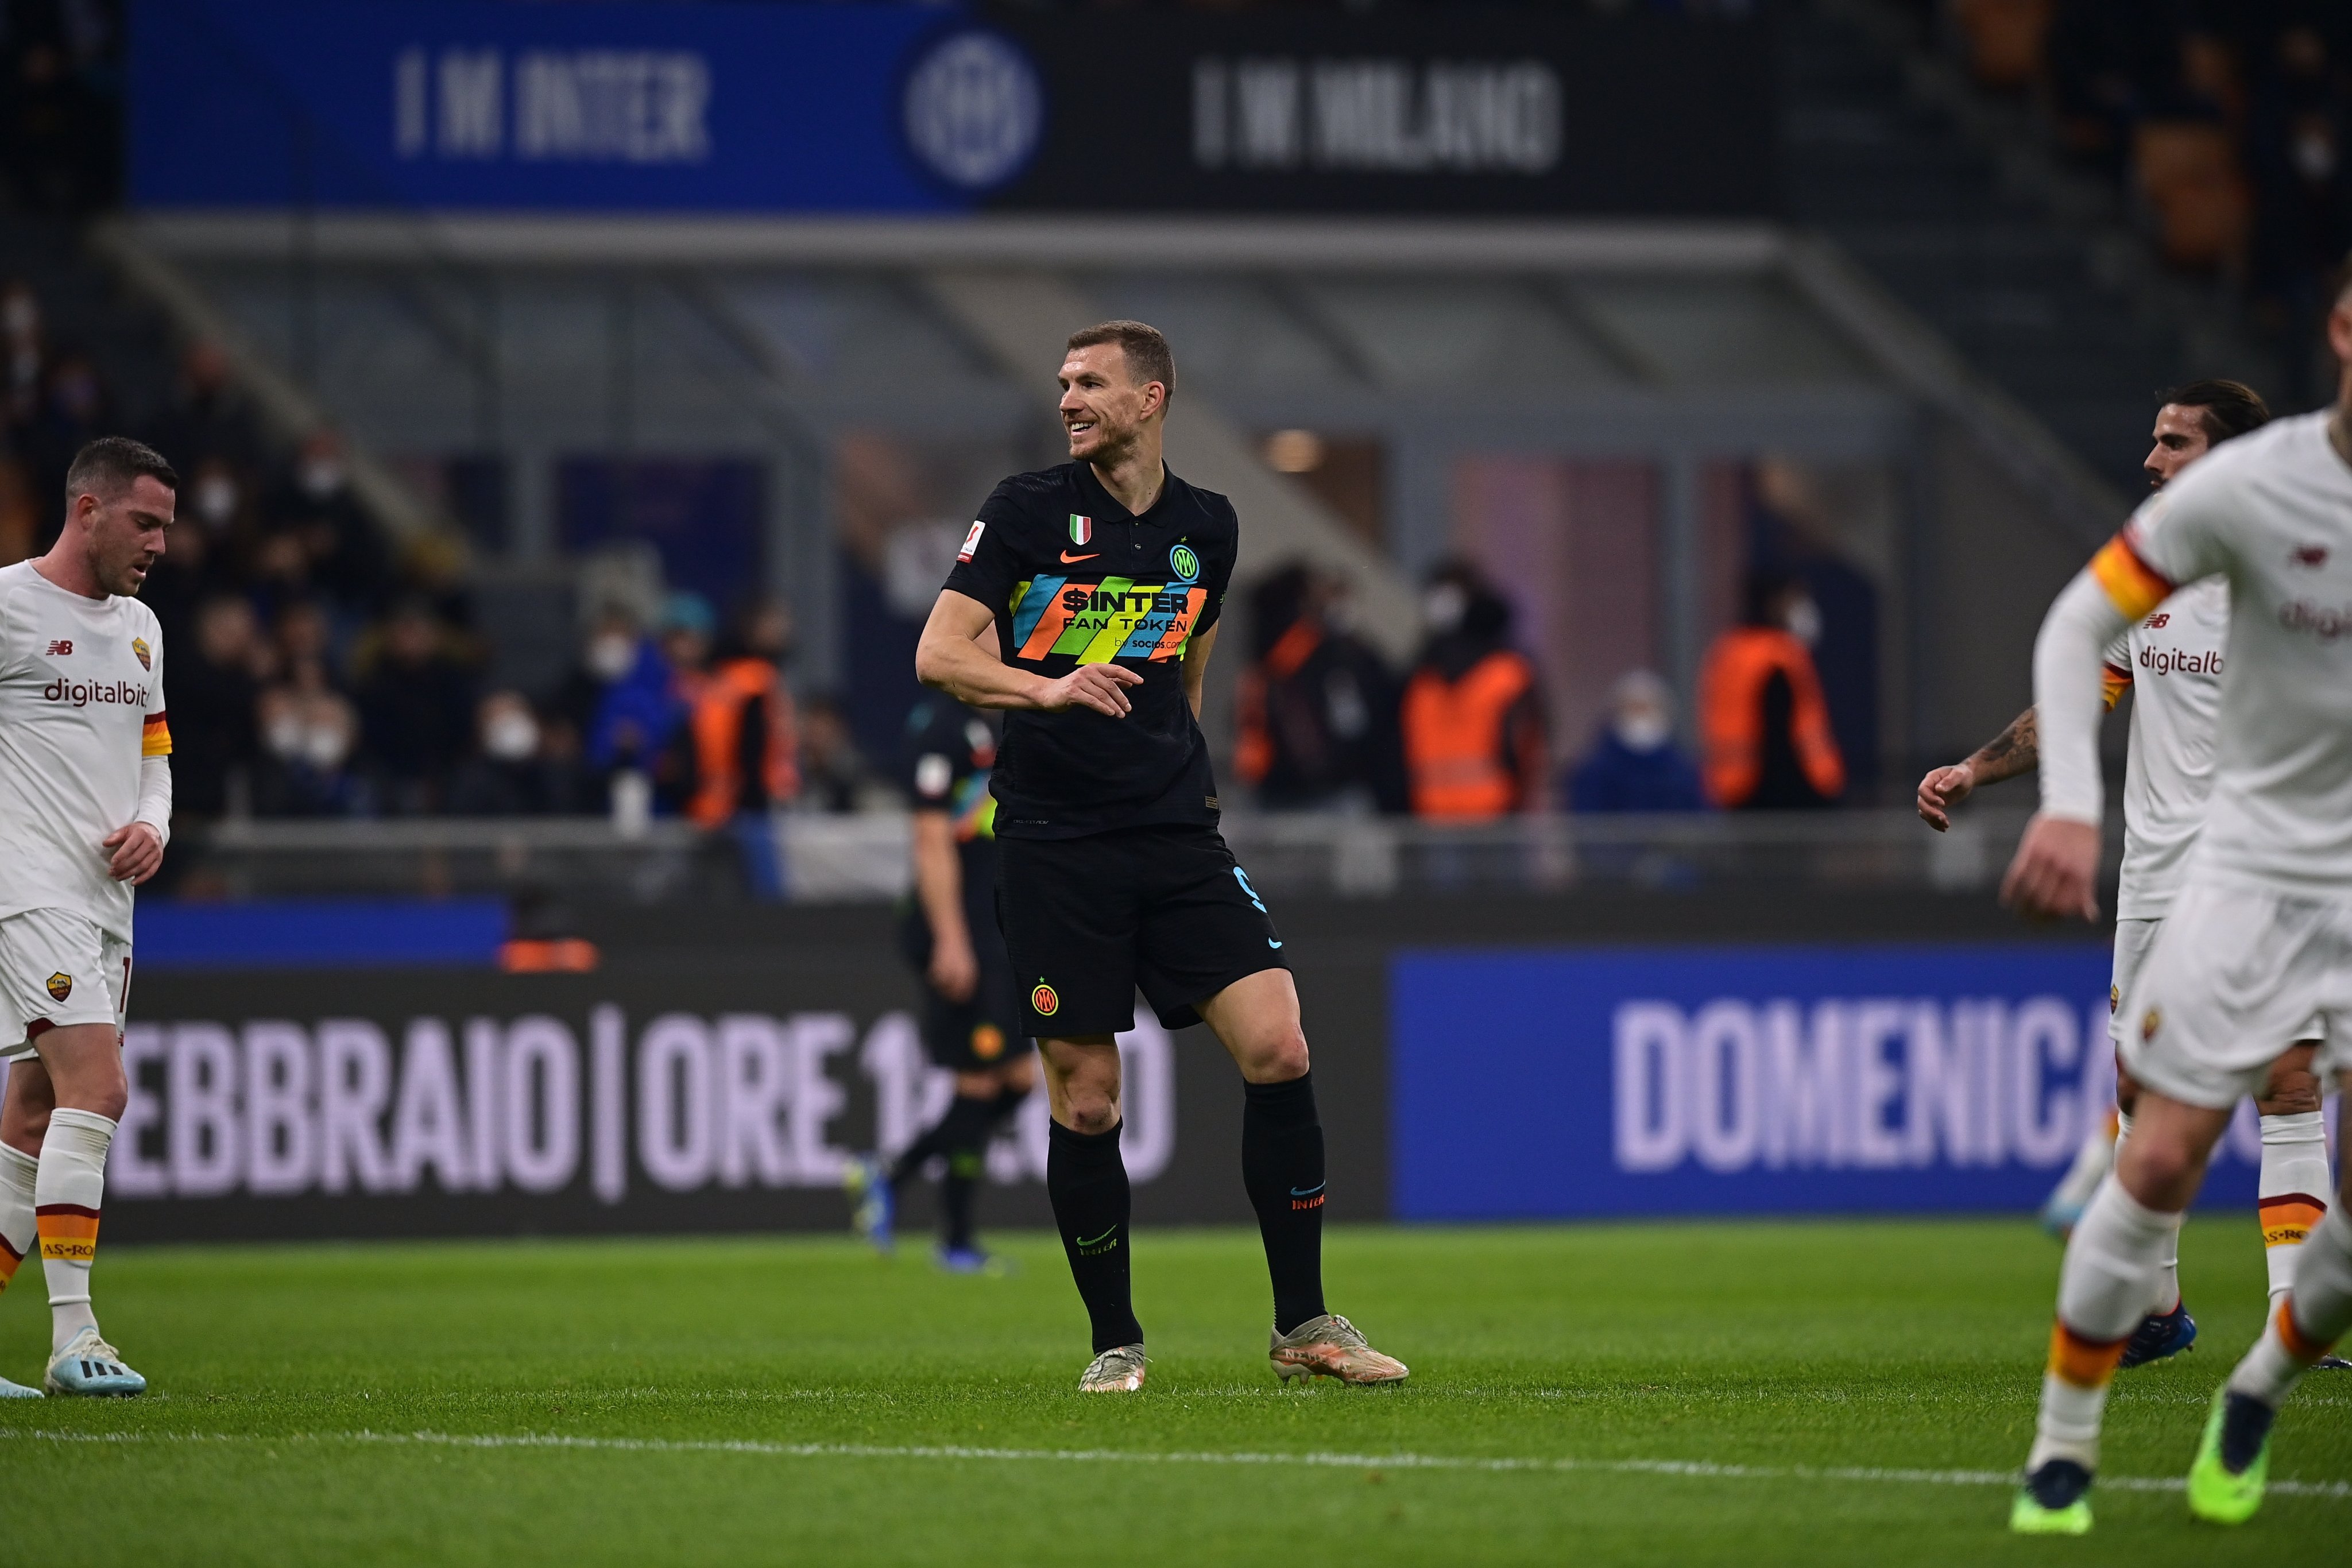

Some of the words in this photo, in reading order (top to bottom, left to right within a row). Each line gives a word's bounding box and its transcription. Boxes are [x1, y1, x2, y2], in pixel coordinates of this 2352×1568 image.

[1062, 588, 1188, 614] $INTER
[1063, 618, 1108, 630] FAN
[1120, 618, 1187, 632] TOKEN
[1115, 637, 1128, 649] by
[2140, 645, 2224, 676] digitalb
[44, 678, 149, 708] digitalbit
[640, 1014, 853, 1192] ORE
